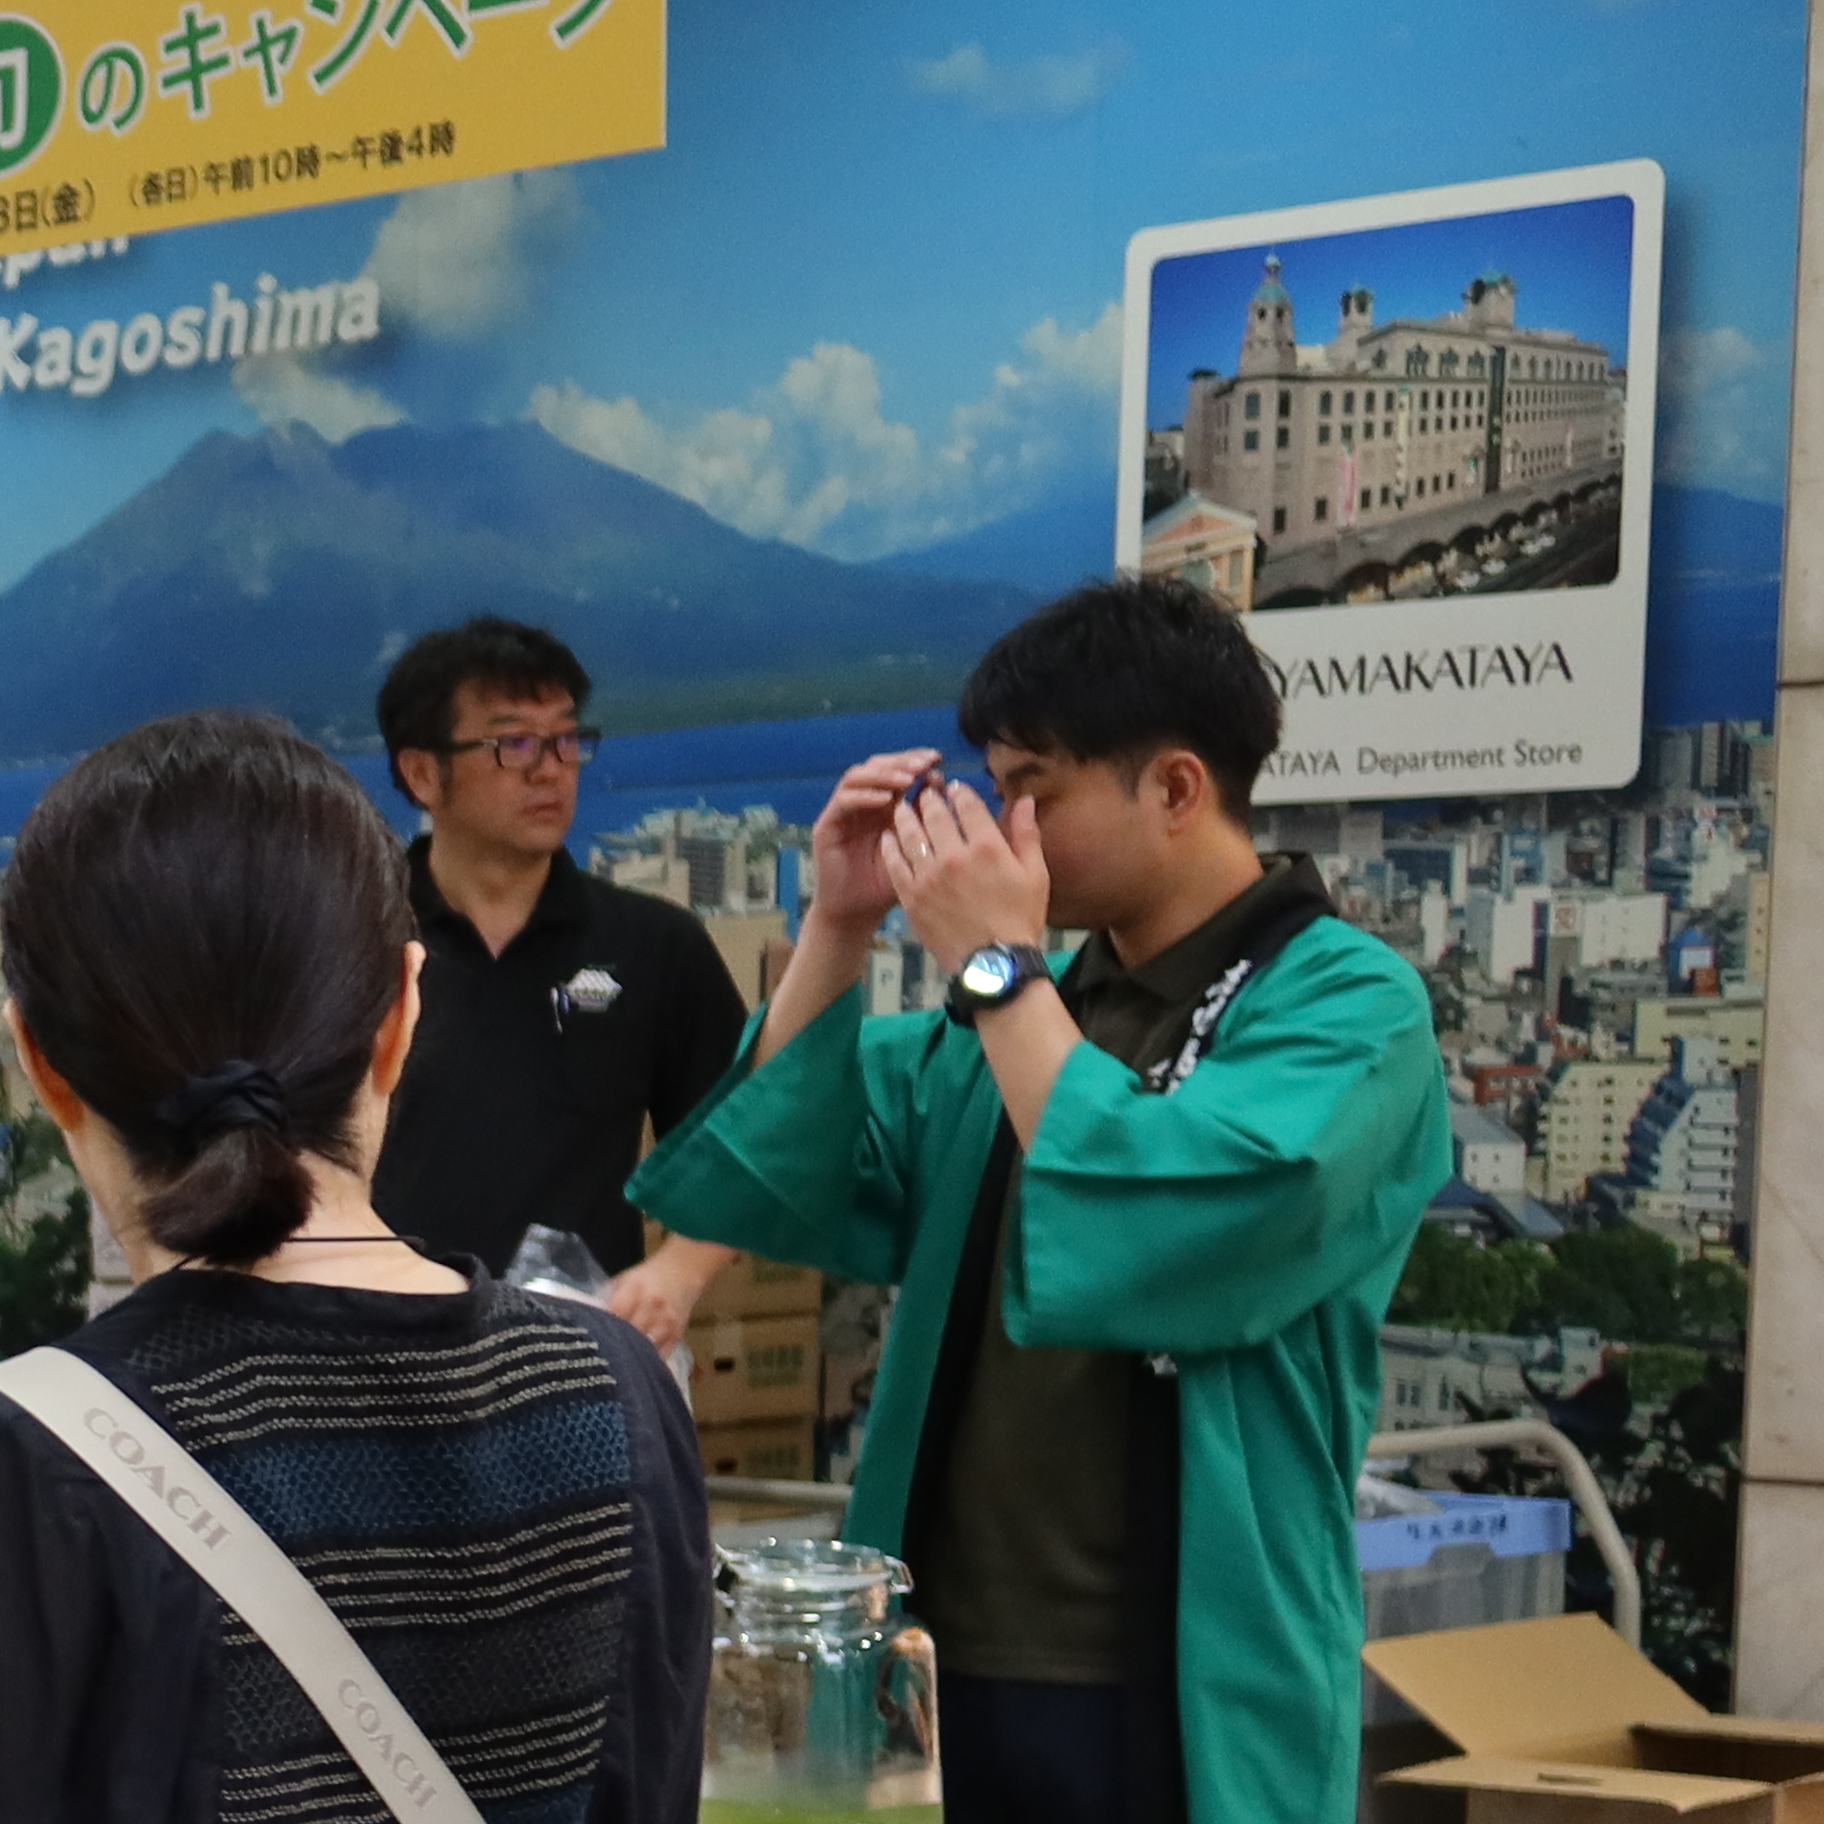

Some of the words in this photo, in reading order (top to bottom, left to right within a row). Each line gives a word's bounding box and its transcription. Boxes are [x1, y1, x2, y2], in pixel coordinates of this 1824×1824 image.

[1357, 744, 1504, 778] Department
[1514, 738, 1583, 767] Store
[82, 1407, 233, 1550] COACH
[337, 1677, 438, 1808] COACH
